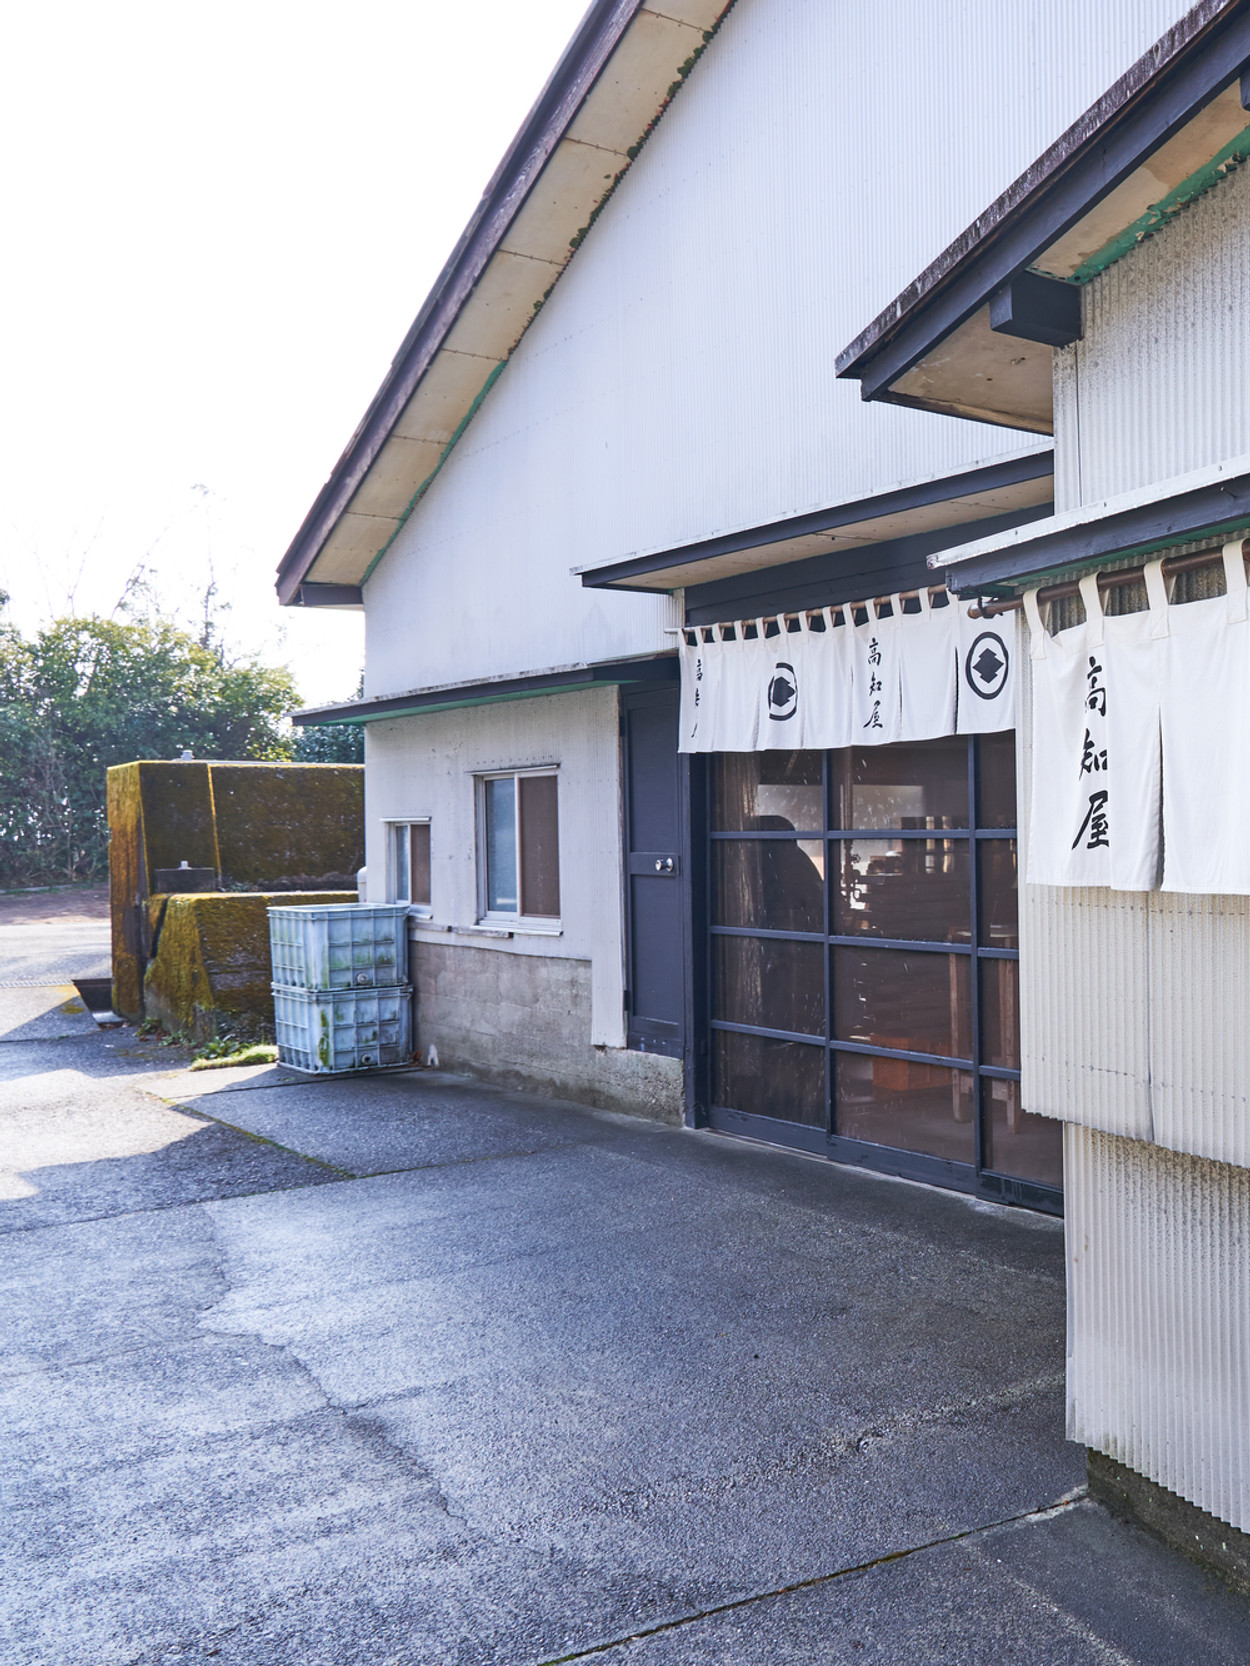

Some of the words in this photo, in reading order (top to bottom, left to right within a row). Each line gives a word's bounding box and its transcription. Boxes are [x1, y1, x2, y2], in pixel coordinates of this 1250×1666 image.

[863, 637, 883, 729] 高知屋
[1072, 656, 1110, 850] 高知屋
